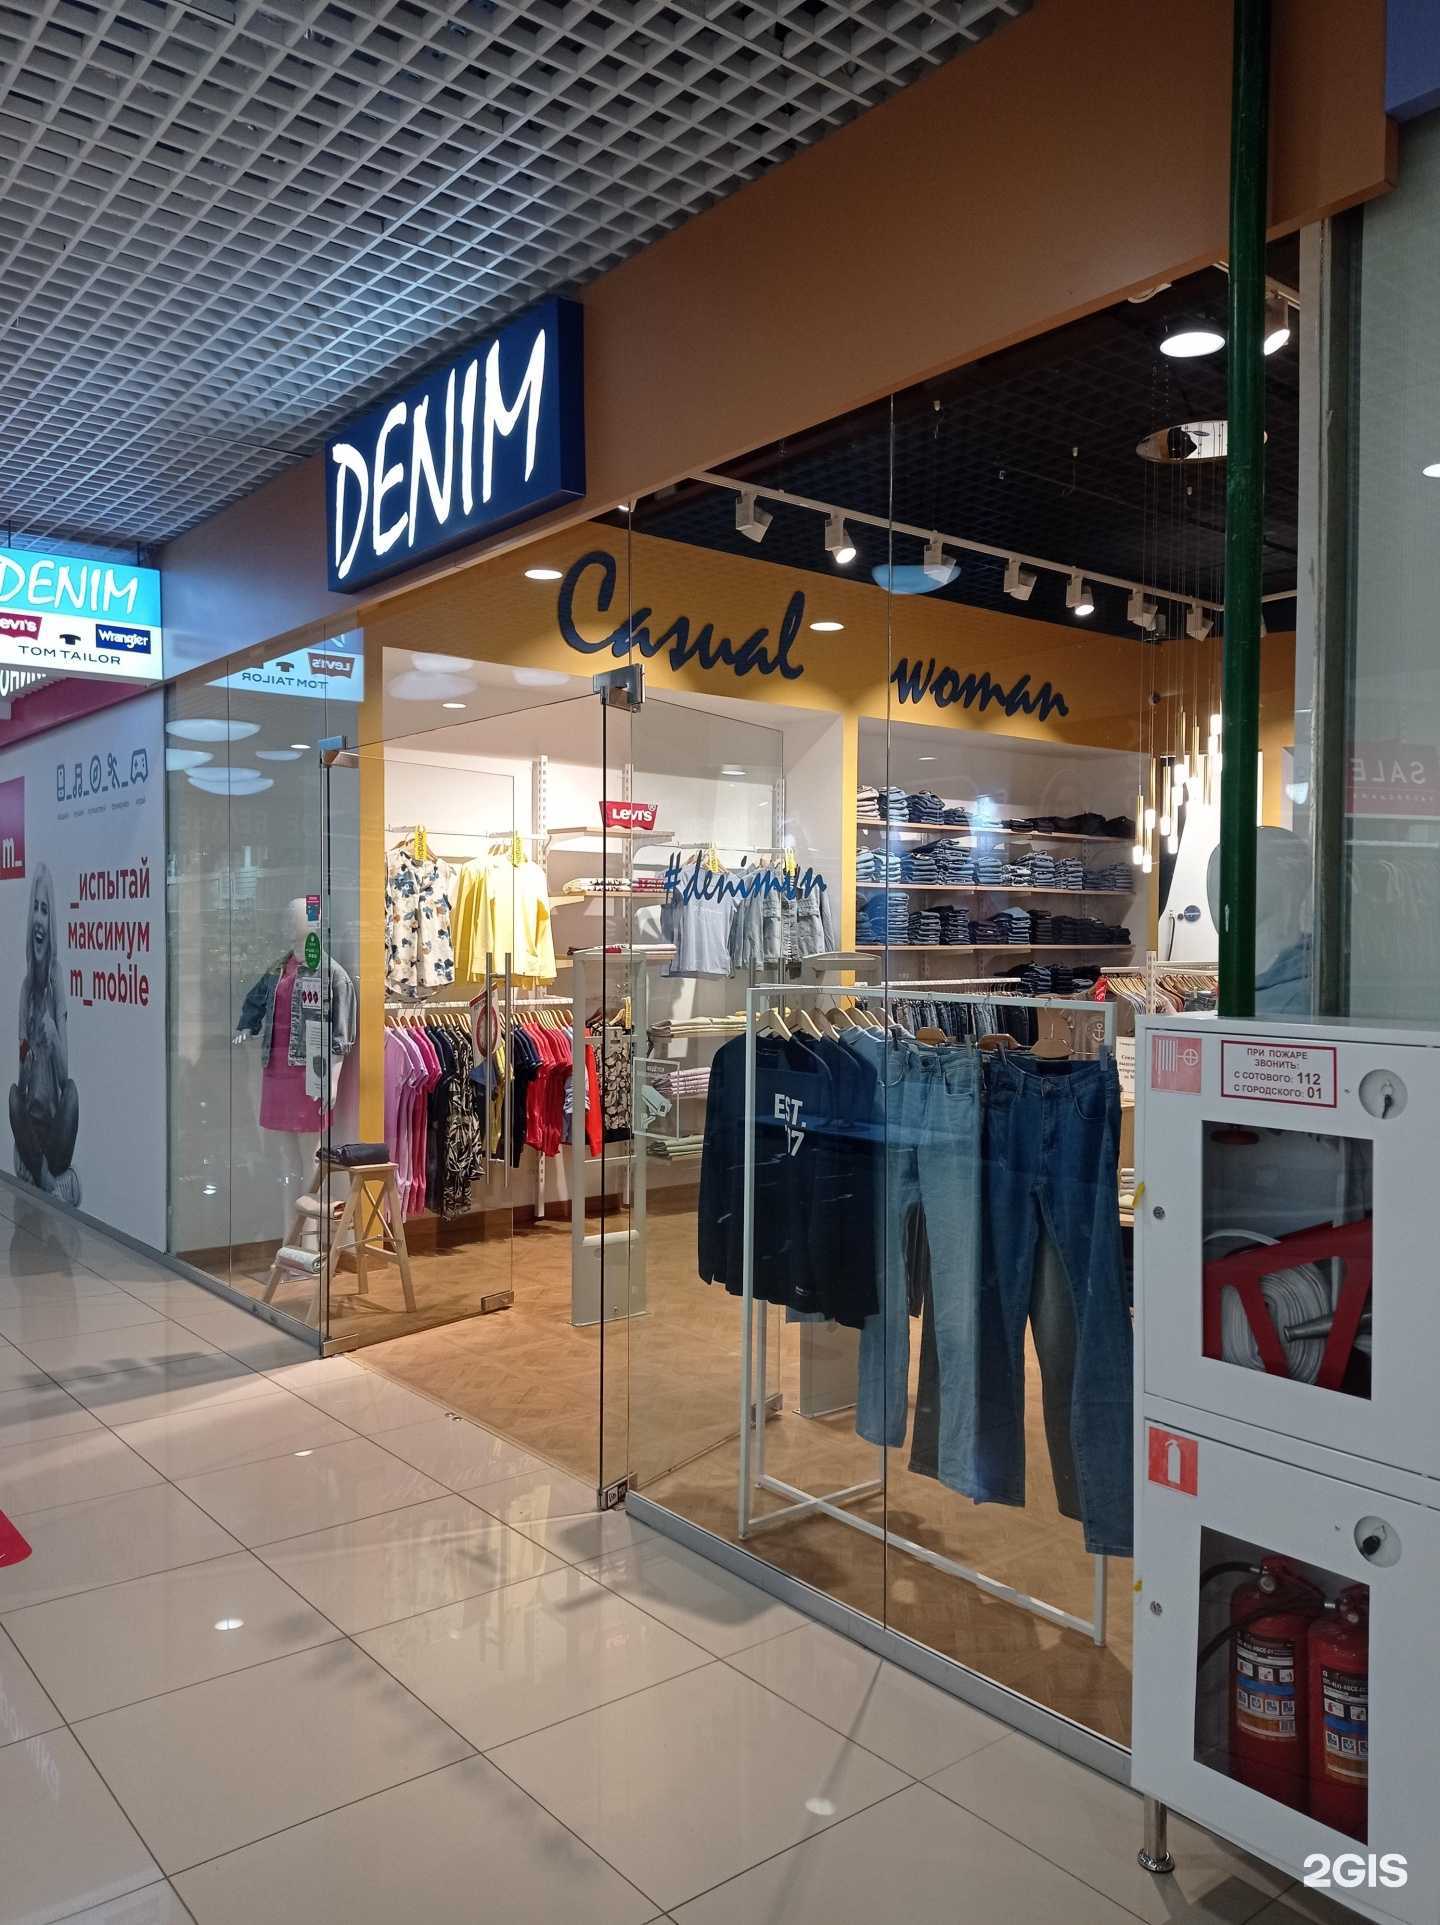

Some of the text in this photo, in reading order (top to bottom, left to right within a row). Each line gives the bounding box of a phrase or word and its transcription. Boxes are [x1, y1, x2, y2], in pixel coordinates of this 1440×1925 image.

[332, 328, 546, 580] DENIM
[0, 555, 138, 614] DENIM
[98, 629, 148, 649] Wrangler
[558, 550, 1068, 722] Casual woman
[18, 645, 121, 665] TOM TAILOR
[68, 920, 150, 960] максимум
[70, 963, 149, 1006] m_mobile
[1246, 1047, 1308, 1061] ПРИ ПОЖАРЕ
[1254, 1058, 1300, 1071] ЗВОНИТЬ:
[1242, 1072, 1294, 1084] СОТОВОГО:
[1297, 1073, 1321, 1086] 112
[1241, 1085, 1304, 1099] ГОРОДСКОГО:
[1307, 1087, 1323, 1101] 01
[774, 1093, 807, 1128] EST.
